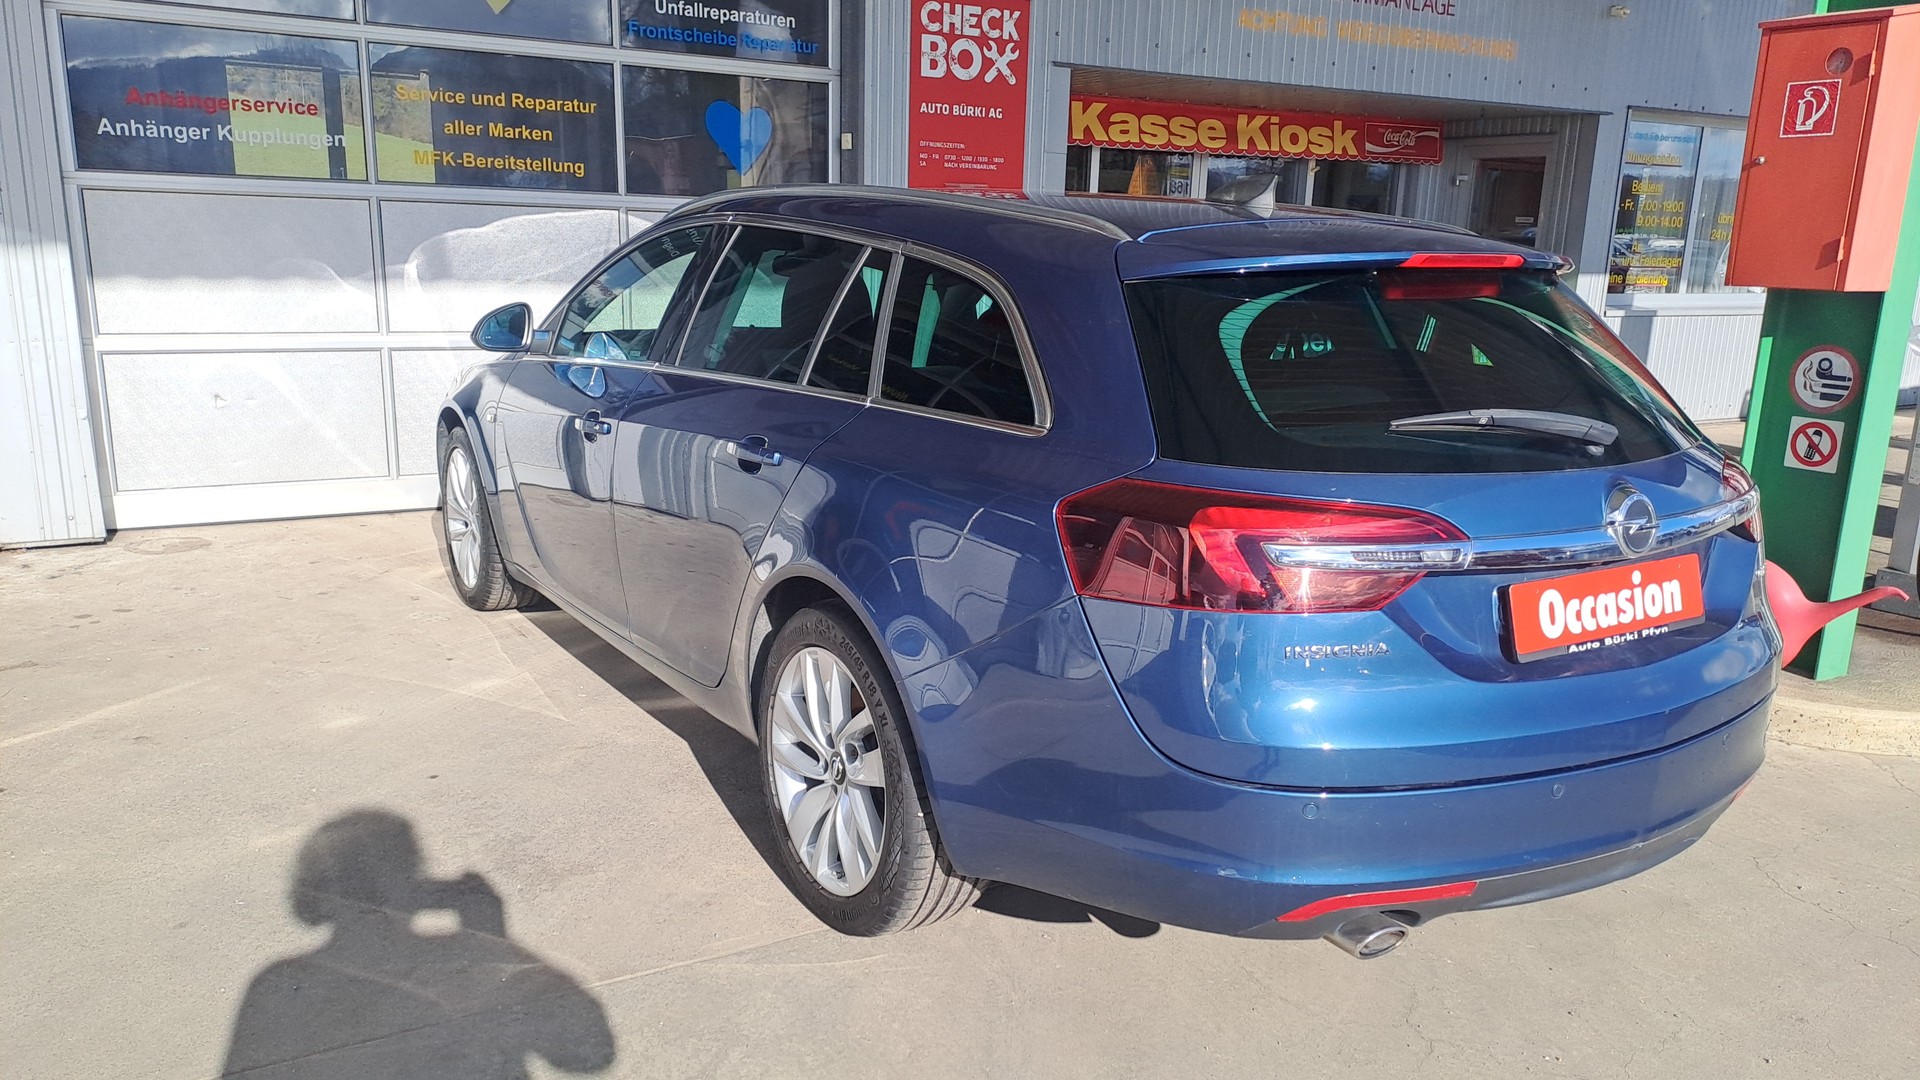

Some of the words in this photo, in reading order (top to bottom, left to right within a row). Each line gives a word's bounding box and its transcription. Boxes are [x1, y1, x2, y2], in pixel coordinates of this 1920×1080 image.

[654, 0, 796, 28] Unfallreparaturen
[920, 0, 1022, 41] CHECK
[627, 19, 737, 46] Frontscheibe
[740, 32, 819, 55] Reparatur
[920, 33, 1020, 86] BOX
[125, 86, 319, 117] Anhängerservice
[395, 84, 466, 104] Service
[472, 92, 506, 107] und
[511, 93, 597, 114] Reparatur
[920, 102, 950, 115] AUTO
[952, 103, 986, 118] BÜRKI
[988, 107, 1003, 119] AG
[96, 117, 211, 145] Anhänger
[217, 124, 346, 152] Kupplungen
[443, 120, 483, 136] aller
[488, 122, 553, 142] Marken
[1071, 101, 1227, 148] Kasse
[1237, 113, 1358, 156] Kiosk
[413, 150, 585, 178] MFK-Bereitstellung
[1538, 569, 1683, 640] Occasion
[1284, 641, 1391, 660] INSIGNIA
[1568, 640, 1600, 653] Auto
[1604, 631, 1639, 646] Bürki
